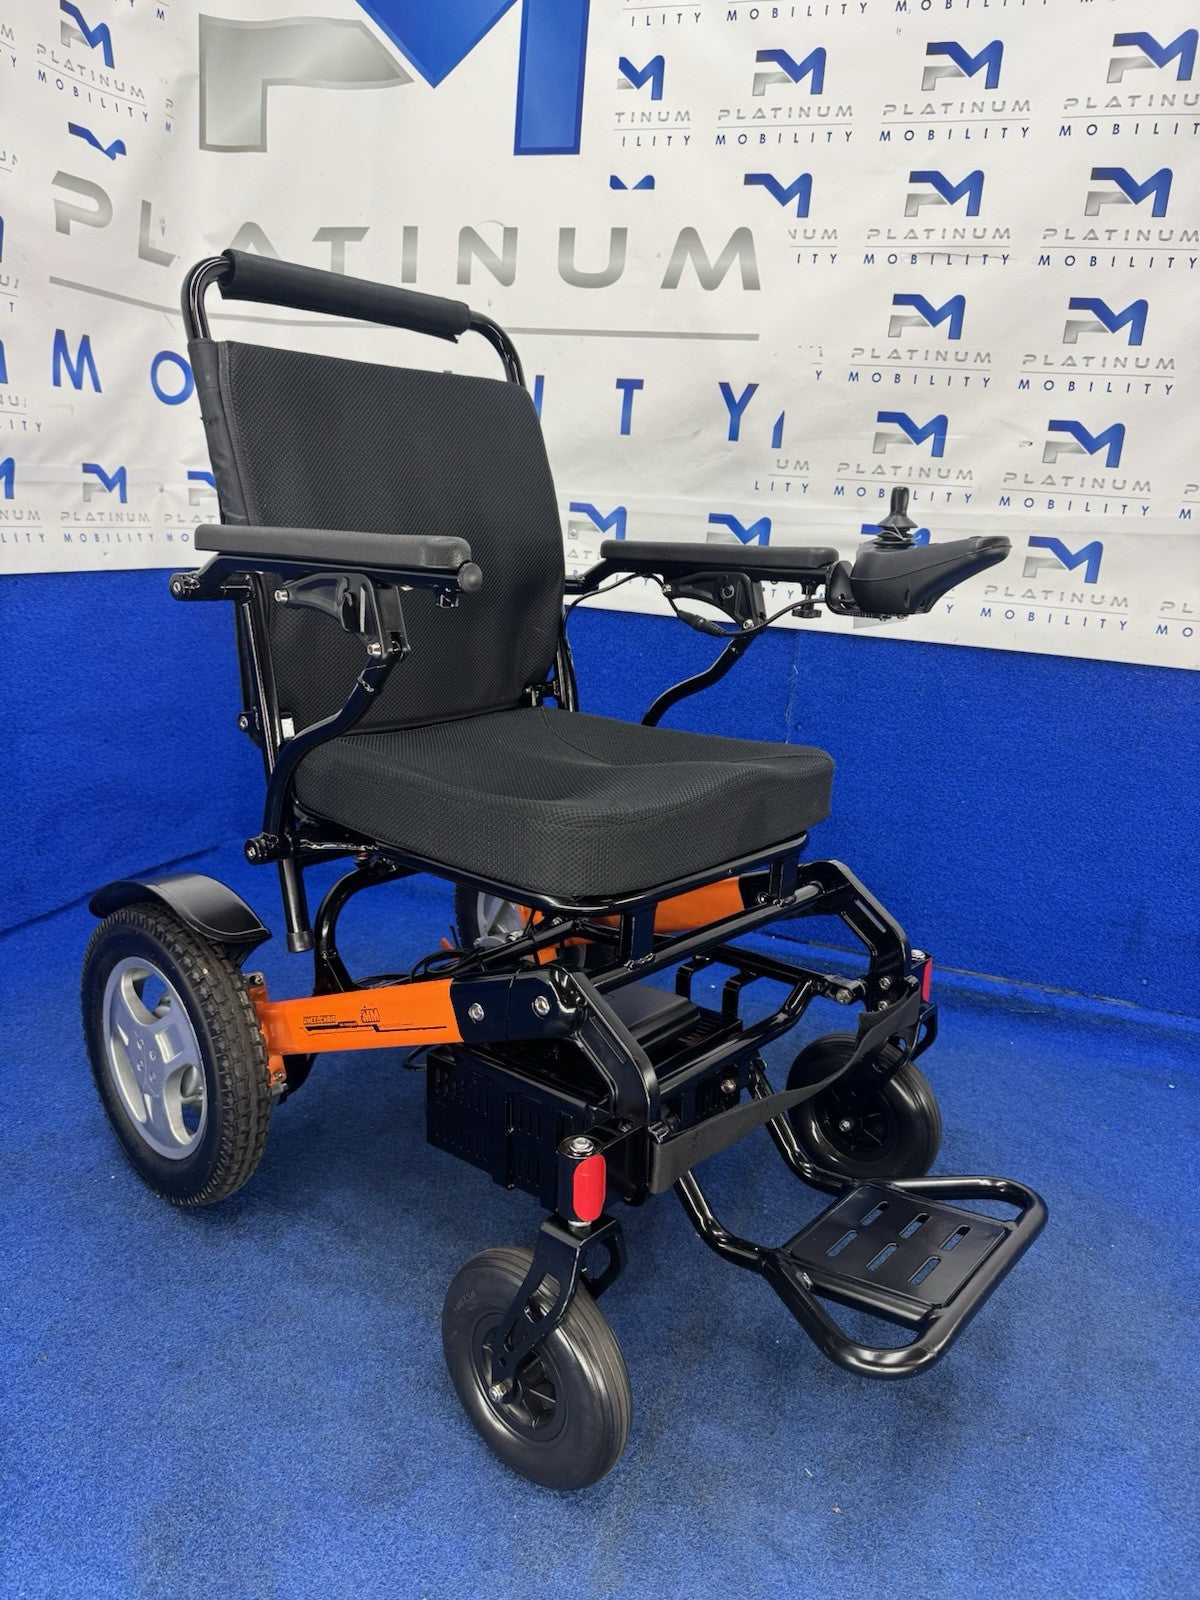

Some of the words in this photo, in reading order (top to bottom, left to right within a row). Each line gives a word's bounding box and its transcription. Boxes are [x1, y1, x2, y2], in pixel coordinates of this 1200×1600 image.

[727, 2, 868, 21] MOBILITY
[36, 43, 146, 99] PLATINUM
[38, 69, 149, 122] MOBILITY
[717, 105, 854, 121] PLATINUM
[883, 100, 1031, 116] PLATINUM
[715, 131, 853, 146] MOBILITY
[879, 126, 1030, 142] MOBILITY
[866, 227, 1011, 241] PLATINUM
[1042, 227, 1200, 243] PLATINUM
[863, 253, 1010, 266] MOBILITY
[1038, 254, 1198, 270] MOBILITY
[851, 347, 992, 365] PLATINUM
[1021, 353, 1176, 371] PLATINUM
[848, 370, 991, 388] MOBILITY
[1018, 378, 1174, 397] MOBILITY
[836, 462, 974, 481] PLATINUM
[1003, 472, 1152, 493] PLATINUM
[832, 485, 973, 504] MOBLITY
[998, 496, 1150, 516] MOBILITY
[60, 511, 151, 522] PLATINUM
[63, 533, 154, 543] MOBILITY
[983, 585, 1130, 609] PLATINUM
[980, 607, 1128, 632] MOBILITY
